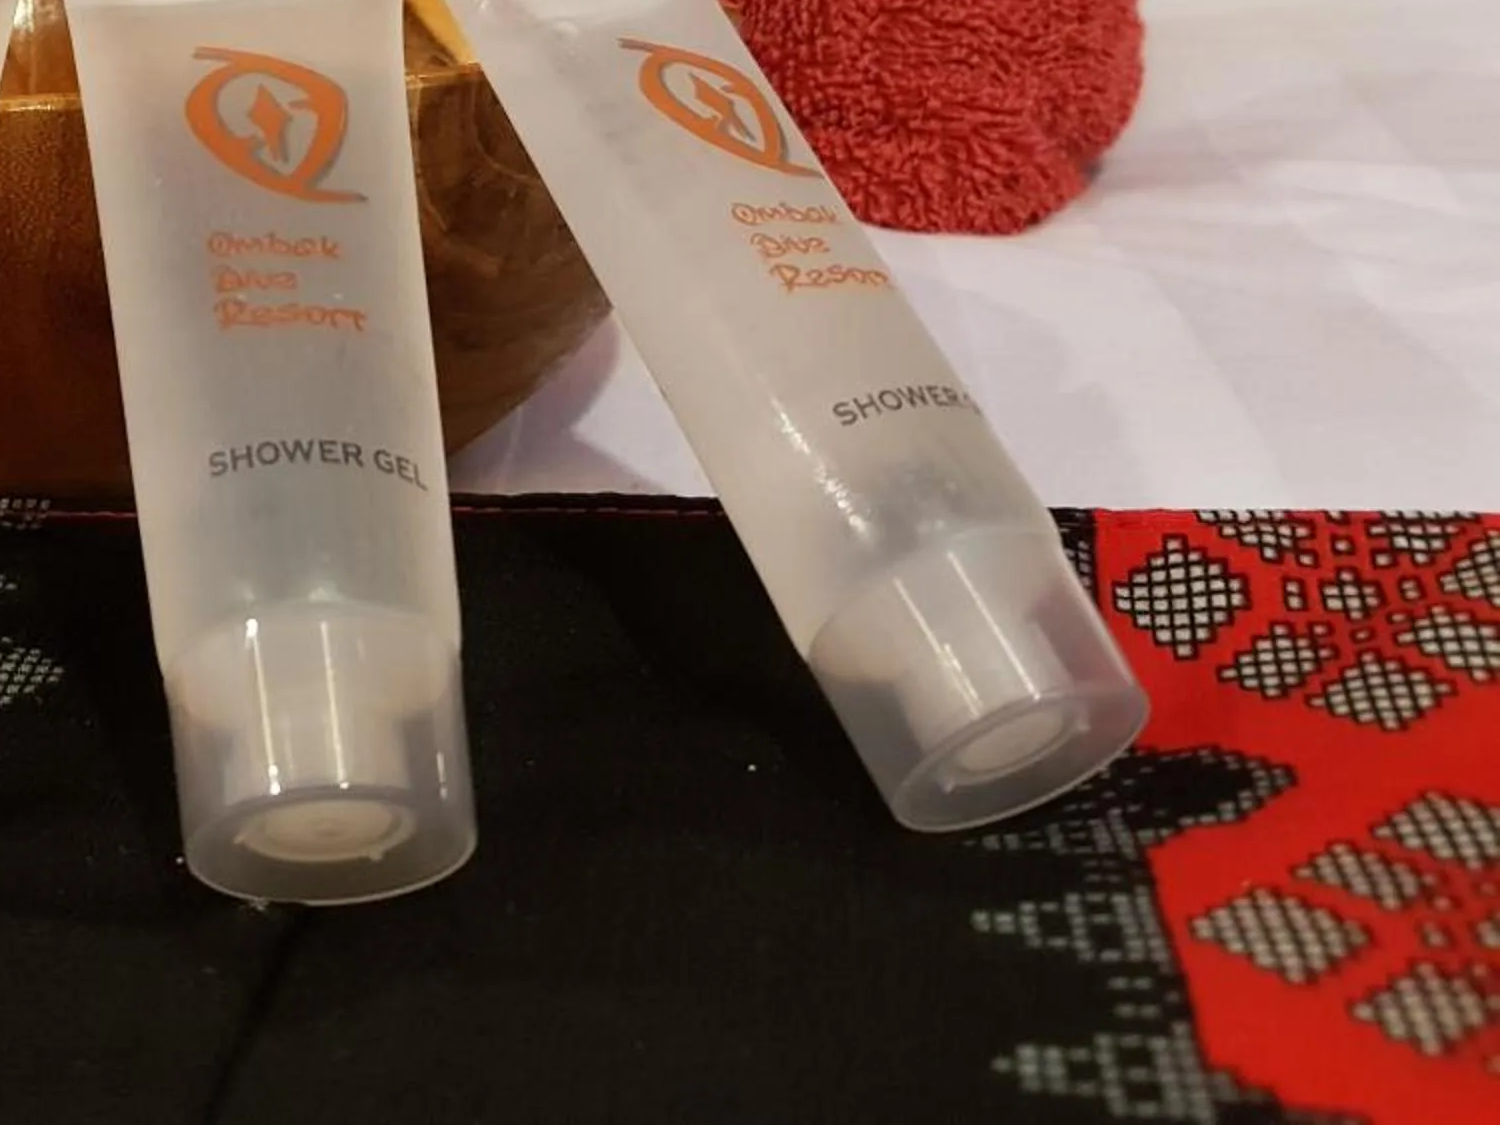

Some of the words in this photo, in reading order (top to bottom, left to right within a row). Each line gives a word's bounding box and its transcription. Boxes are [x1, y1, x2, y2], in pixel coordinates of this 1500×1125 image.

[208, 231, 341, 258] Ombak
[208, 439, 364, 477] SHOWER
[373, 448, 428, 491] GEL
